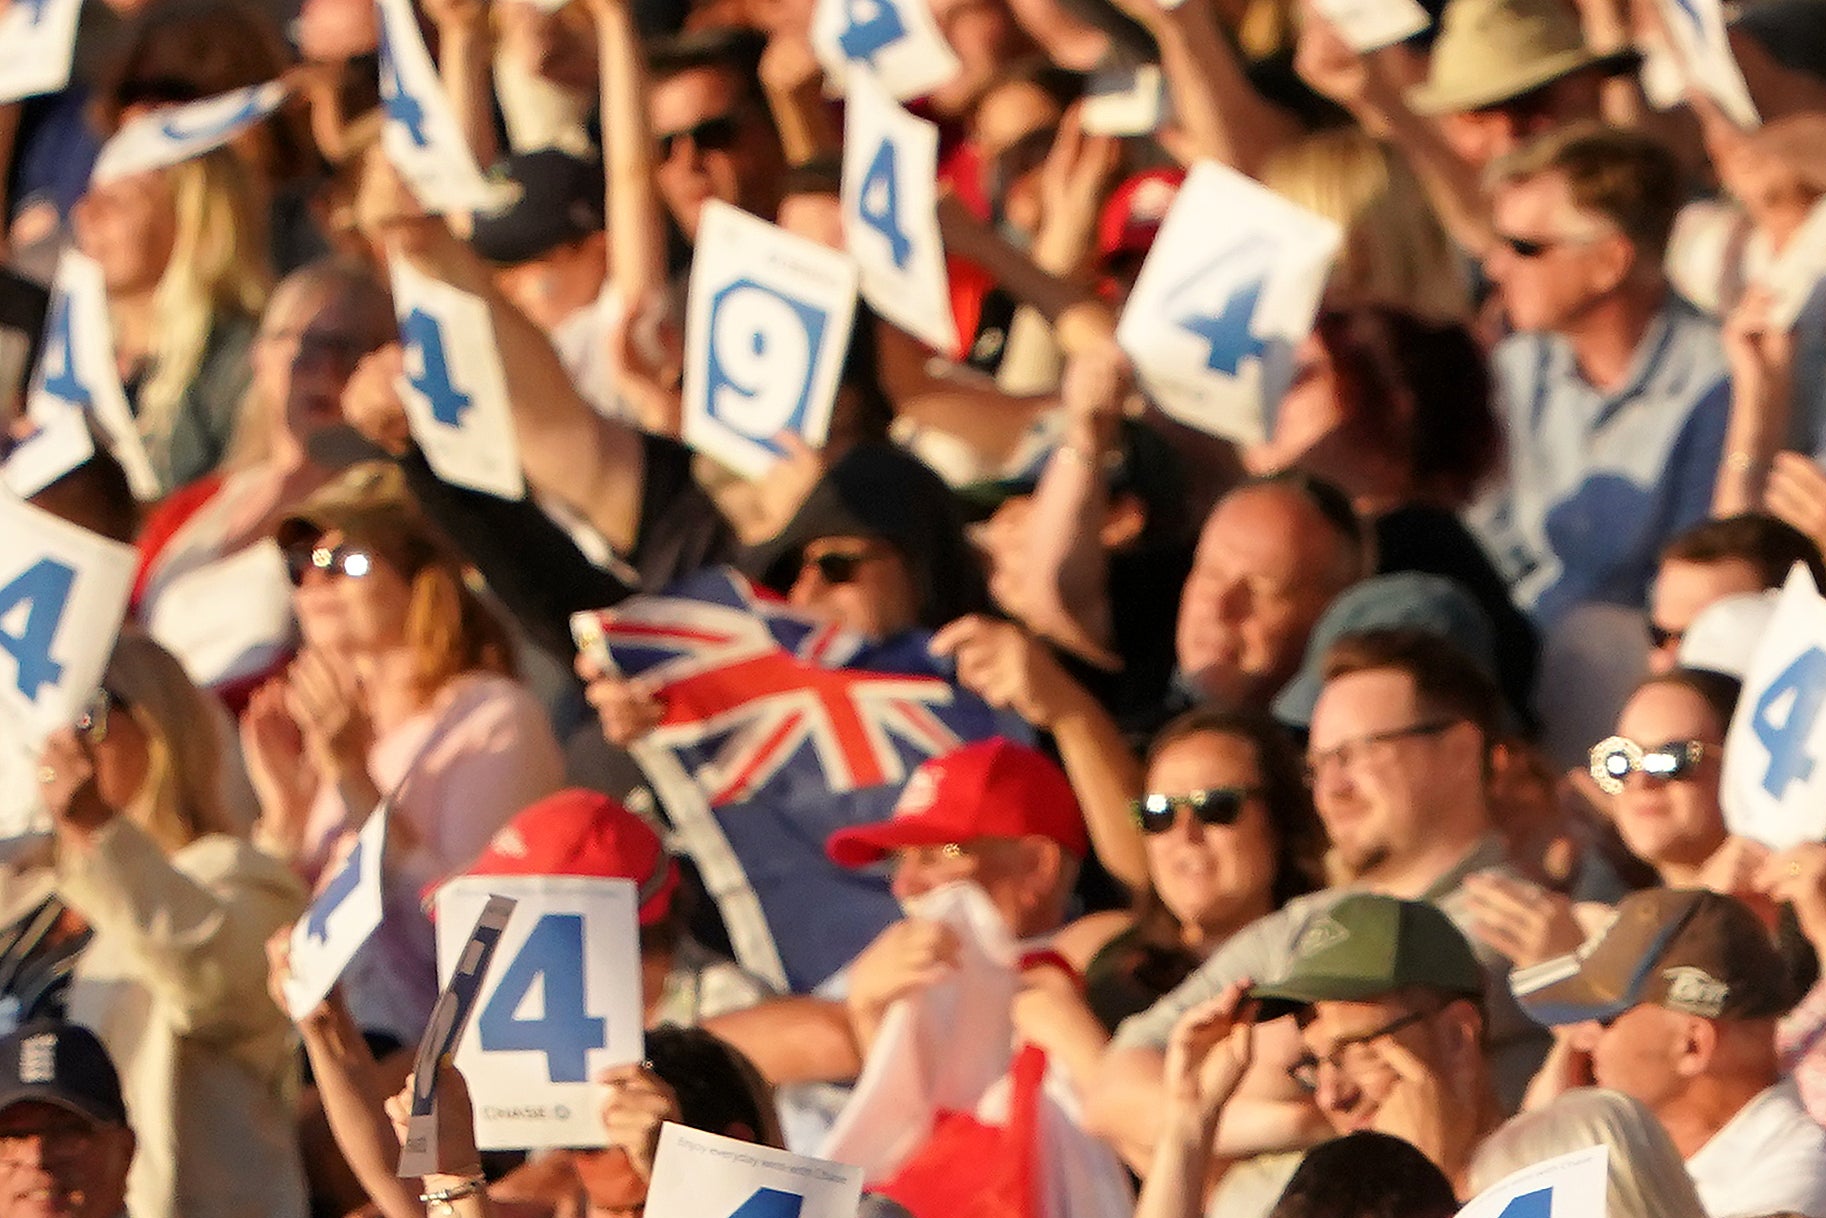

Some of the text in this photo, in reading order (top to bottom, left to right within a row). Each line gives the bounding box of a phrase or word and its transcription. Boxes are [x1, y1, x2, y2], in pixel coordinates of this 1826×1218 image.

[0, 560, 74, 698] 4
[1753, 649, 1826, 794] 4
[480, 915, 604, 1081] 4
